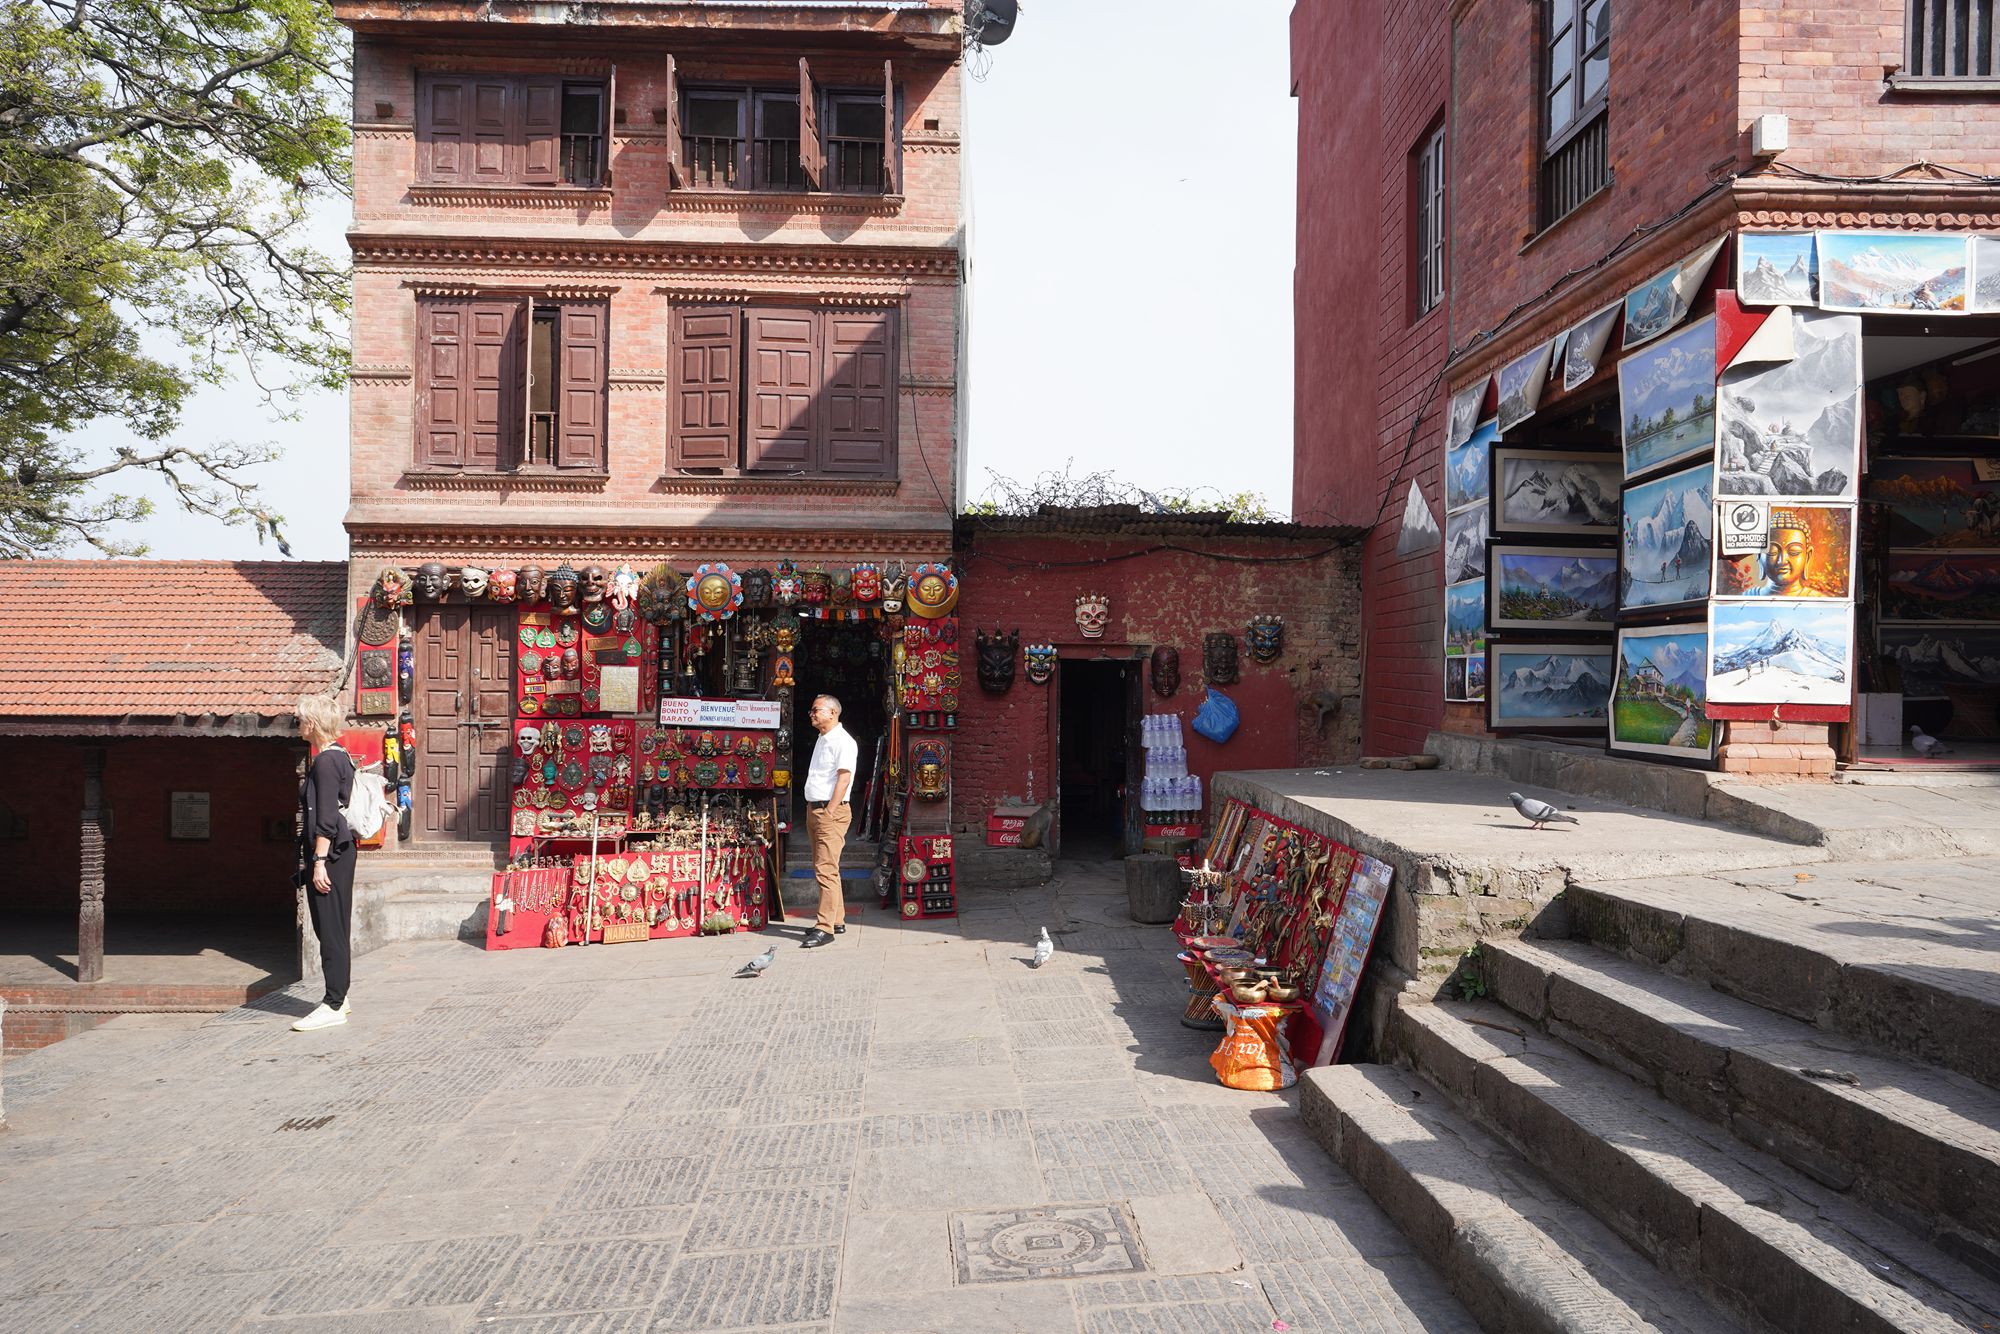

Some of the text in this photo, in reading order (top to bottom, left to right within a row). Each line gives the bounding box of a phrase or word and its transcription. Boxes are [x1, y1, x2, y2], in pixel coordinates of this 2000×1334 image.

[700, 705, 735, 713] BIENVENUE
[661, 715, 693, 723] BARATO
[605, 925, 646, 941] NAMASTE
